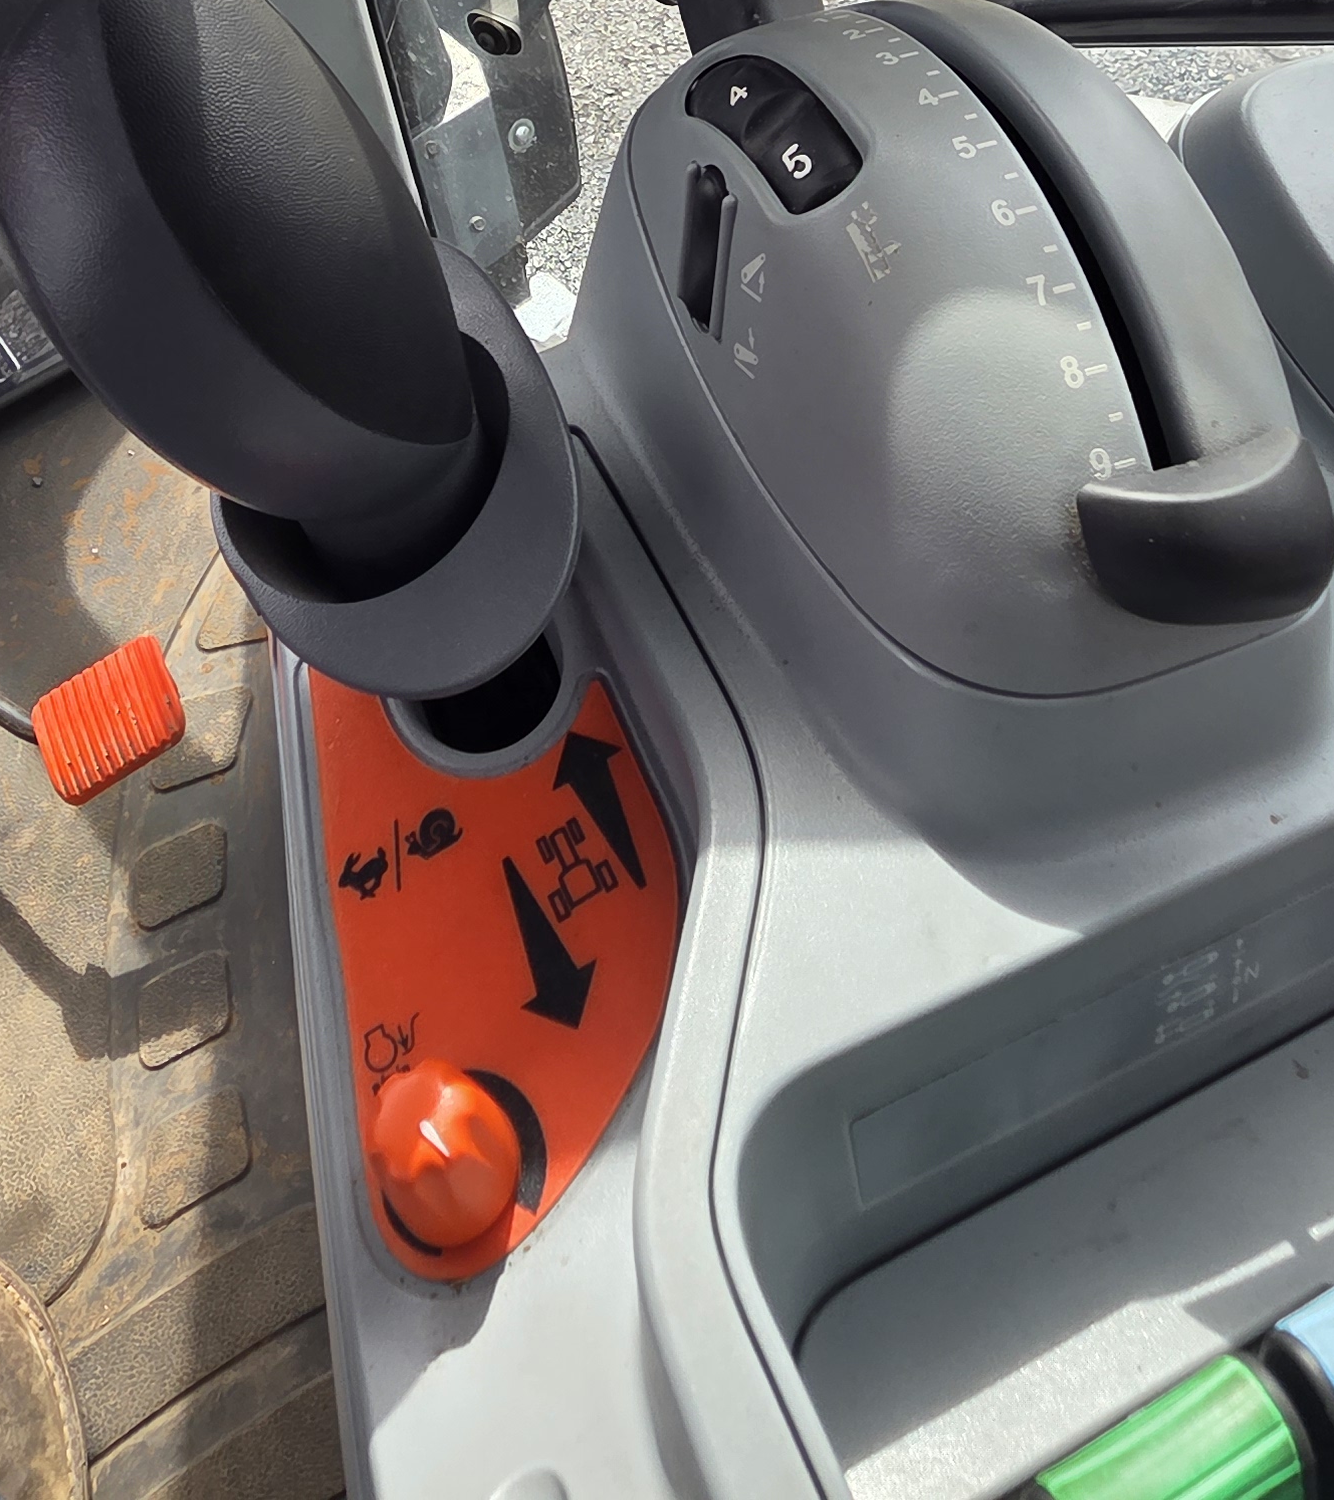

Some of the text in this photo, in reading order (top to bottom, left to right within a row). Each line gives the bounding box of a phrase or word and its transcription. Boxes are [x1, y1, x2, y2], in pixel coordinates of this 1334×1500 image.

[842, 28, 867, 41] 2
[875, 51, 900, 66] 3
[727, 85, 748, 107] 4
[918, 87, 939, 106] 4
[951, 134, 978, 160] 5
[781, 143, 813, 180] 5
[990, 199, 1016, 227] 6
[1025, 274, 1049, 305] 7
[1058, 355, 1086, 389] 8
[1087, 447, 1114, 479] 9
